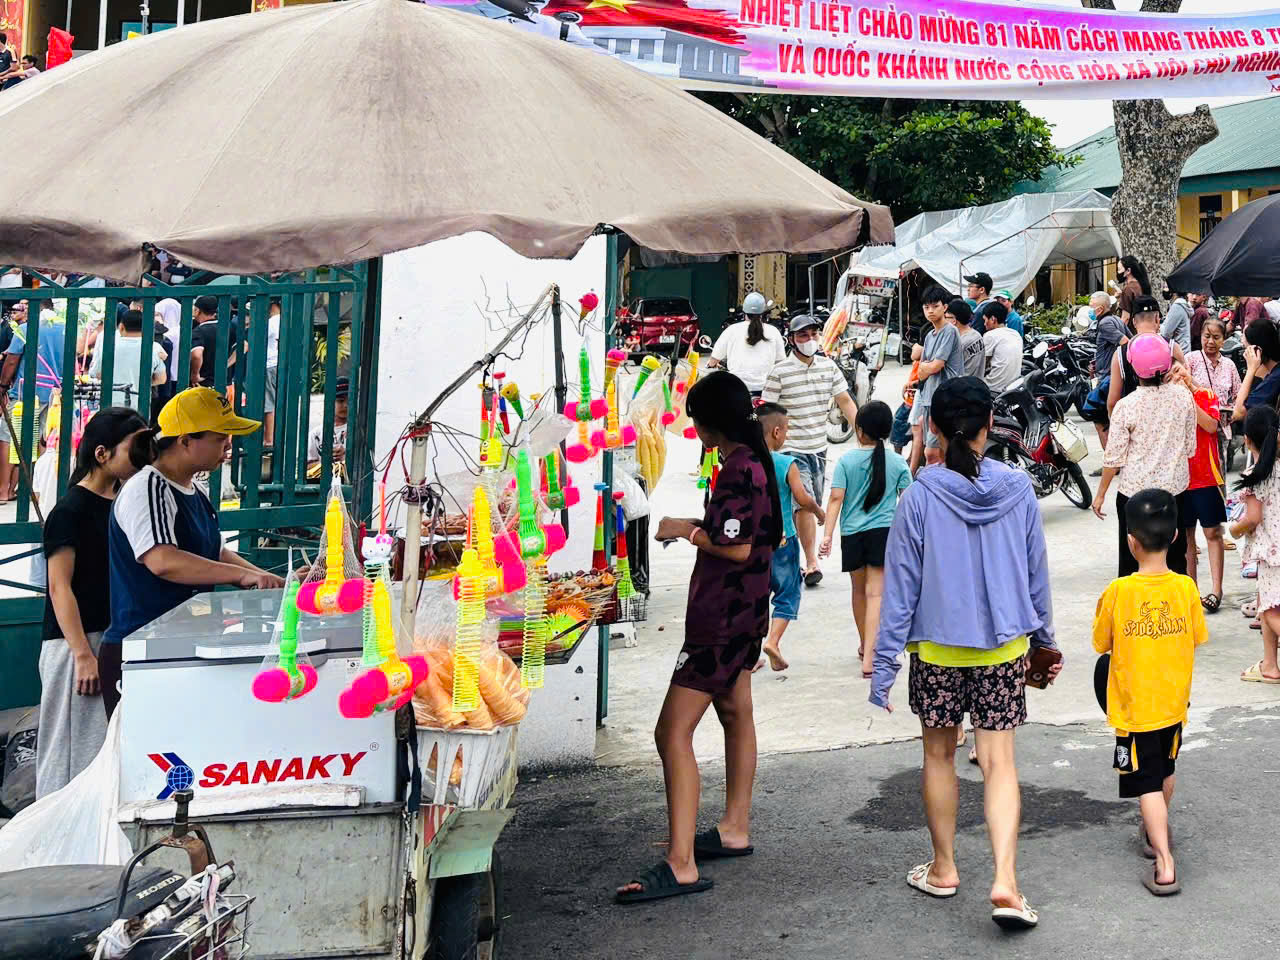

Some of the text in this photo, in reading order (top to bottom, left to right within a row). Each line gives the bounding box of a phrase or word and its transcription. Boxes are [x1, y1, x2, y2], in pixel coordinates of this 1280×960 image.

[858, 2, 913, 40] CHÀO
[919, 8, 980, 46] MỪNG
[985, 22, 1007, 47] 81
[1013, 19, 1062, 52] NĂM
[1066, 24, 1118, 53] CÁCH
[1123, 30, 1182, 56] MẠNG
[1184, 27, 1249, 51] THÁNG
[1253, 29, 1265, 48] 8
[777, 38, 806, 76] VÀ
[812, 36, 870, 79] QUỐC
[877, 44, 949, 82] KHÁNH
[954, 53, 1010, 82] NƯỚC
[1016, 56, 1073, 86] CỘNG
[1077, 59, 1120, 81] HÒA
[1123, 59, 1151, 80] XÃ
[1123, 617, 1188, 640] SPIDER-MAN
[199, 751, 368, 788] SANAKY
[135, 874, 184, 900] HONDA
